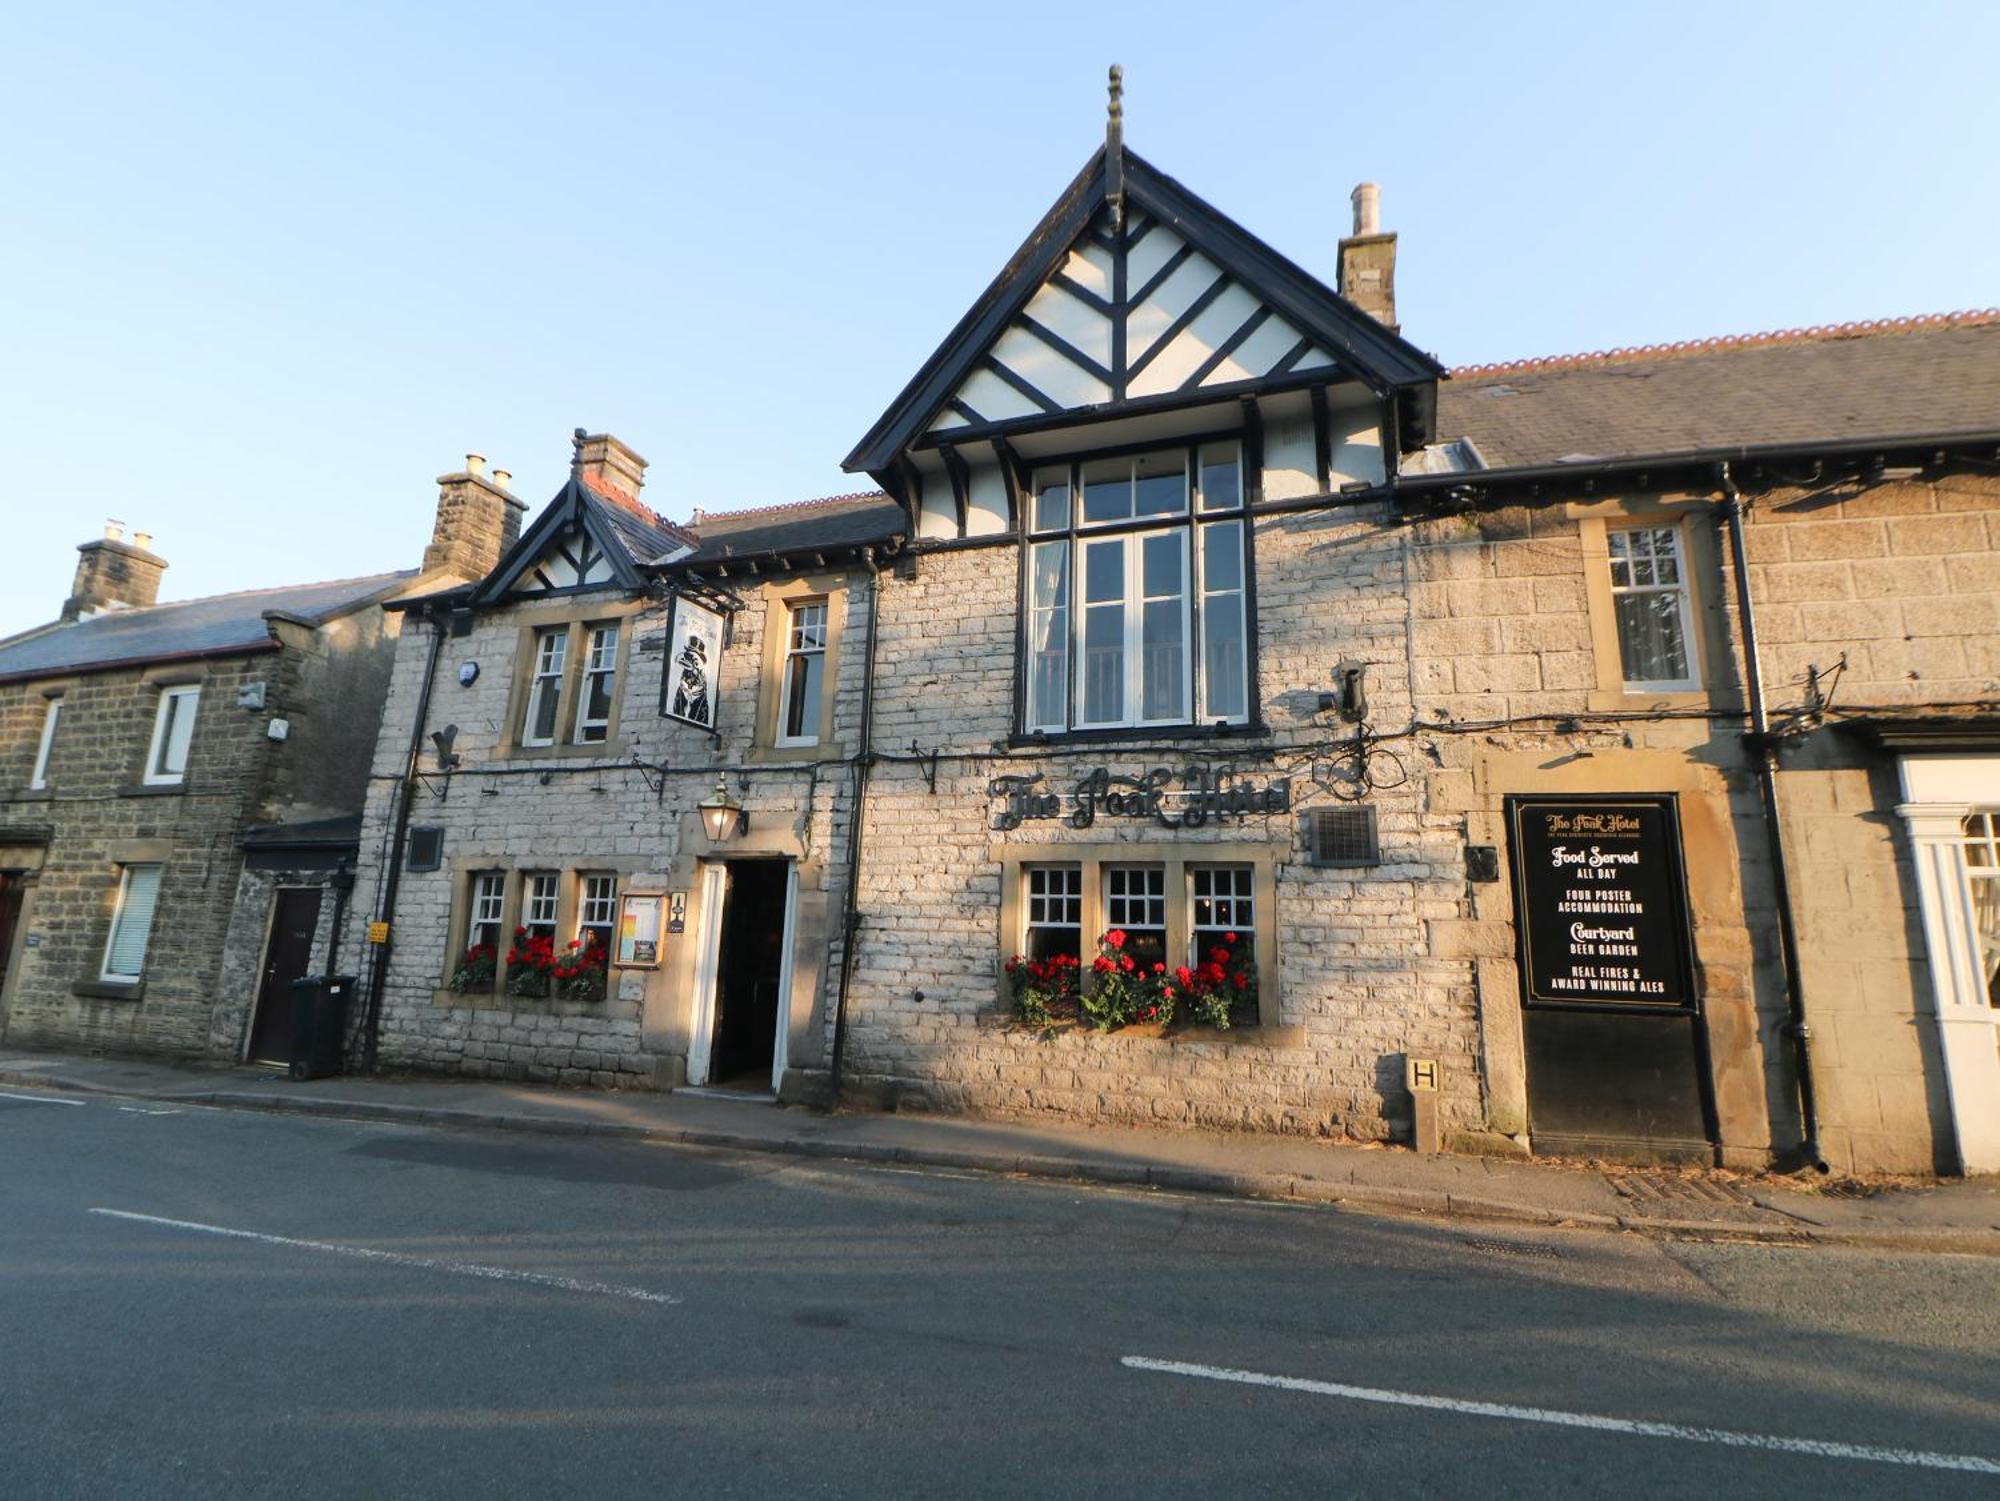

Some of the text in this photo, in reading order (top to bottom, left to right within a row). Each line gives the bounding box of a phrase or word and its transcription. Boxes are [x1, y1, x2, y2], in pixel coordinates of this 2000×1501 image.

[989, 771, 1060, 830] The
[1073, 767, 1181, 829] Peak
[1545, 814, 1640, 832] The Peak Hotel
[1552, 846, 1639, 867] Food Served
[1577, 868, 1616, 879] ALL DAY
[1566, 889, 1632, 902] FOUR POSTER
[1558, 901, 1643, 914] ACCOMMODATION
[1570, 922, 1635, 943] Courtyard
[1570, 943, 1638, 956] BEER GARDEN
[1571, 966, 1641, 979] REAL FIRES &
[1551, 978, 1665, 993] AWARD WINNING ALES
[1414, 1062, 1434, 1087] H
